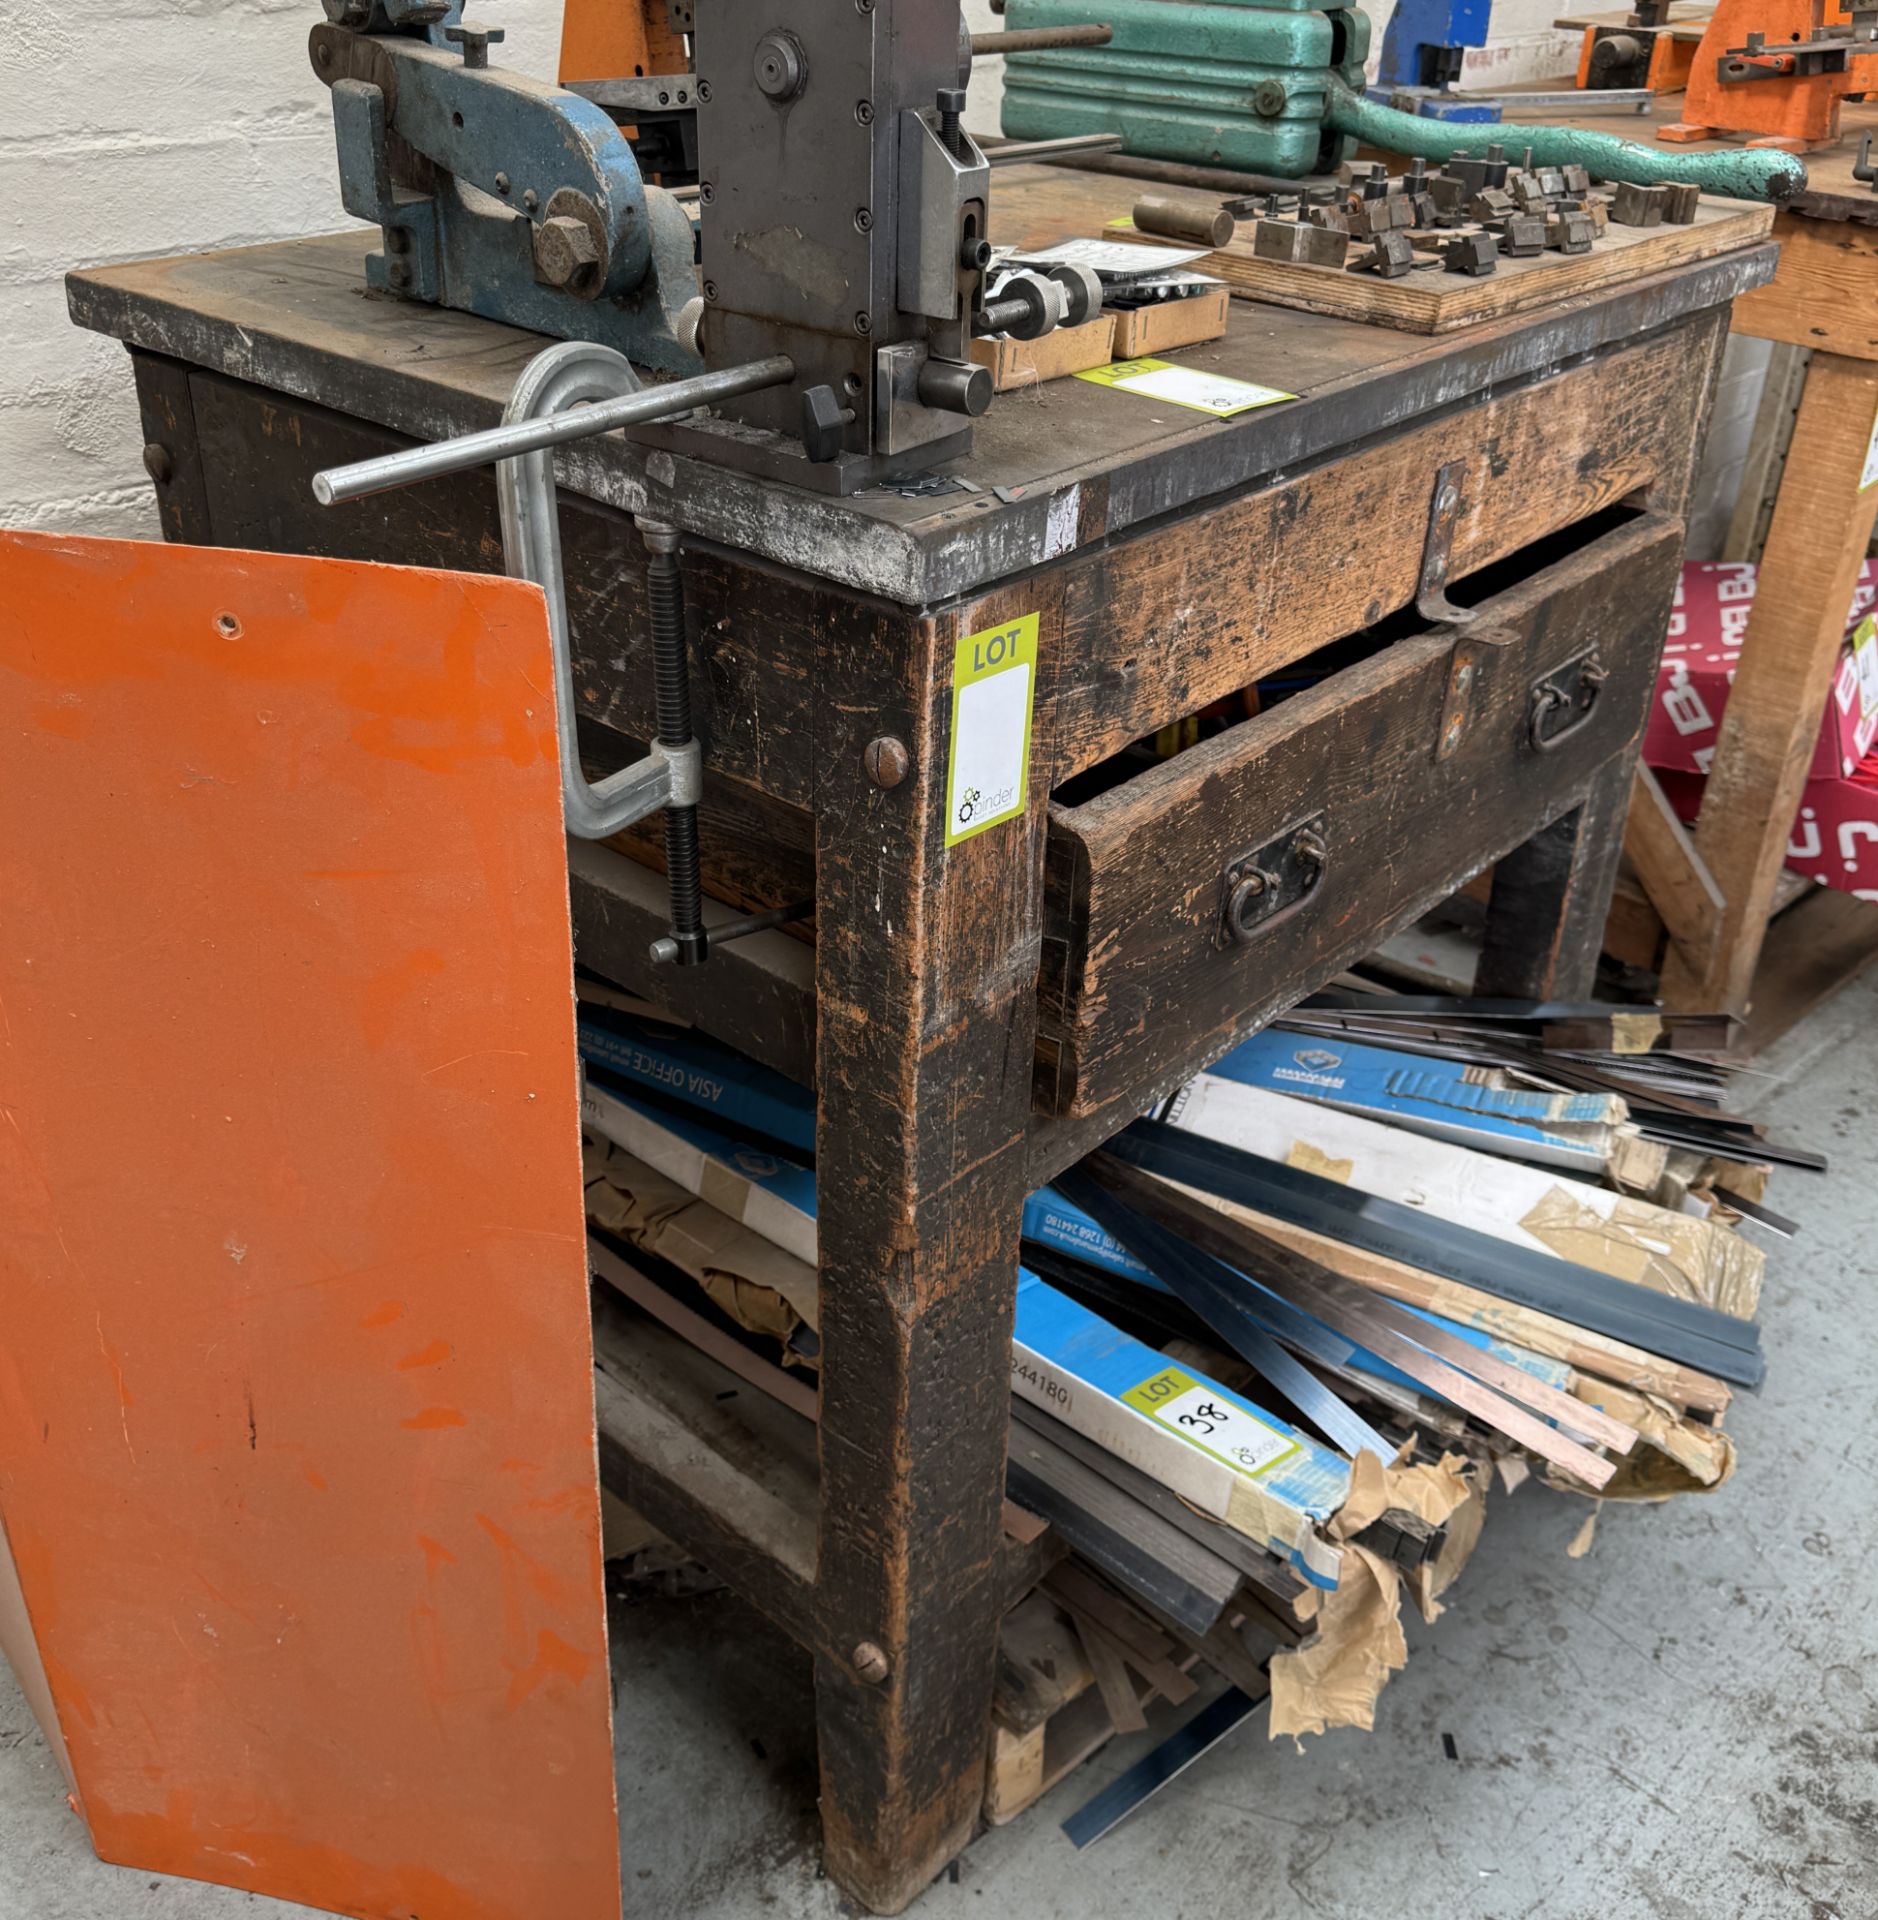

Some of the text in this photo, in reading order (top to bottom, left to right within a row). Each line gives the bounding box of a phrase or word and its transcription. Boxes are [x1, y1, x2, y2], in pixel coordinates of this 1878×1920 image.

[1098, 362, 1151, 378] LOT
[973, 627, 1022, 673] LOT
[973, 786, 1015, 822] pinder
[632, 1051, 685, 1087] OFFICE
[688, 1073, 724, 1102] ASIA
[1044, 1213, 1080, 1234] 244180
[1079, 1226, 1101, 1244] 1268
[1010, 1356, 1068, 1404] 244180
[1138, 1375, 1181, 1404] LOT
[1178, 1402, 1230, 1435] 38
